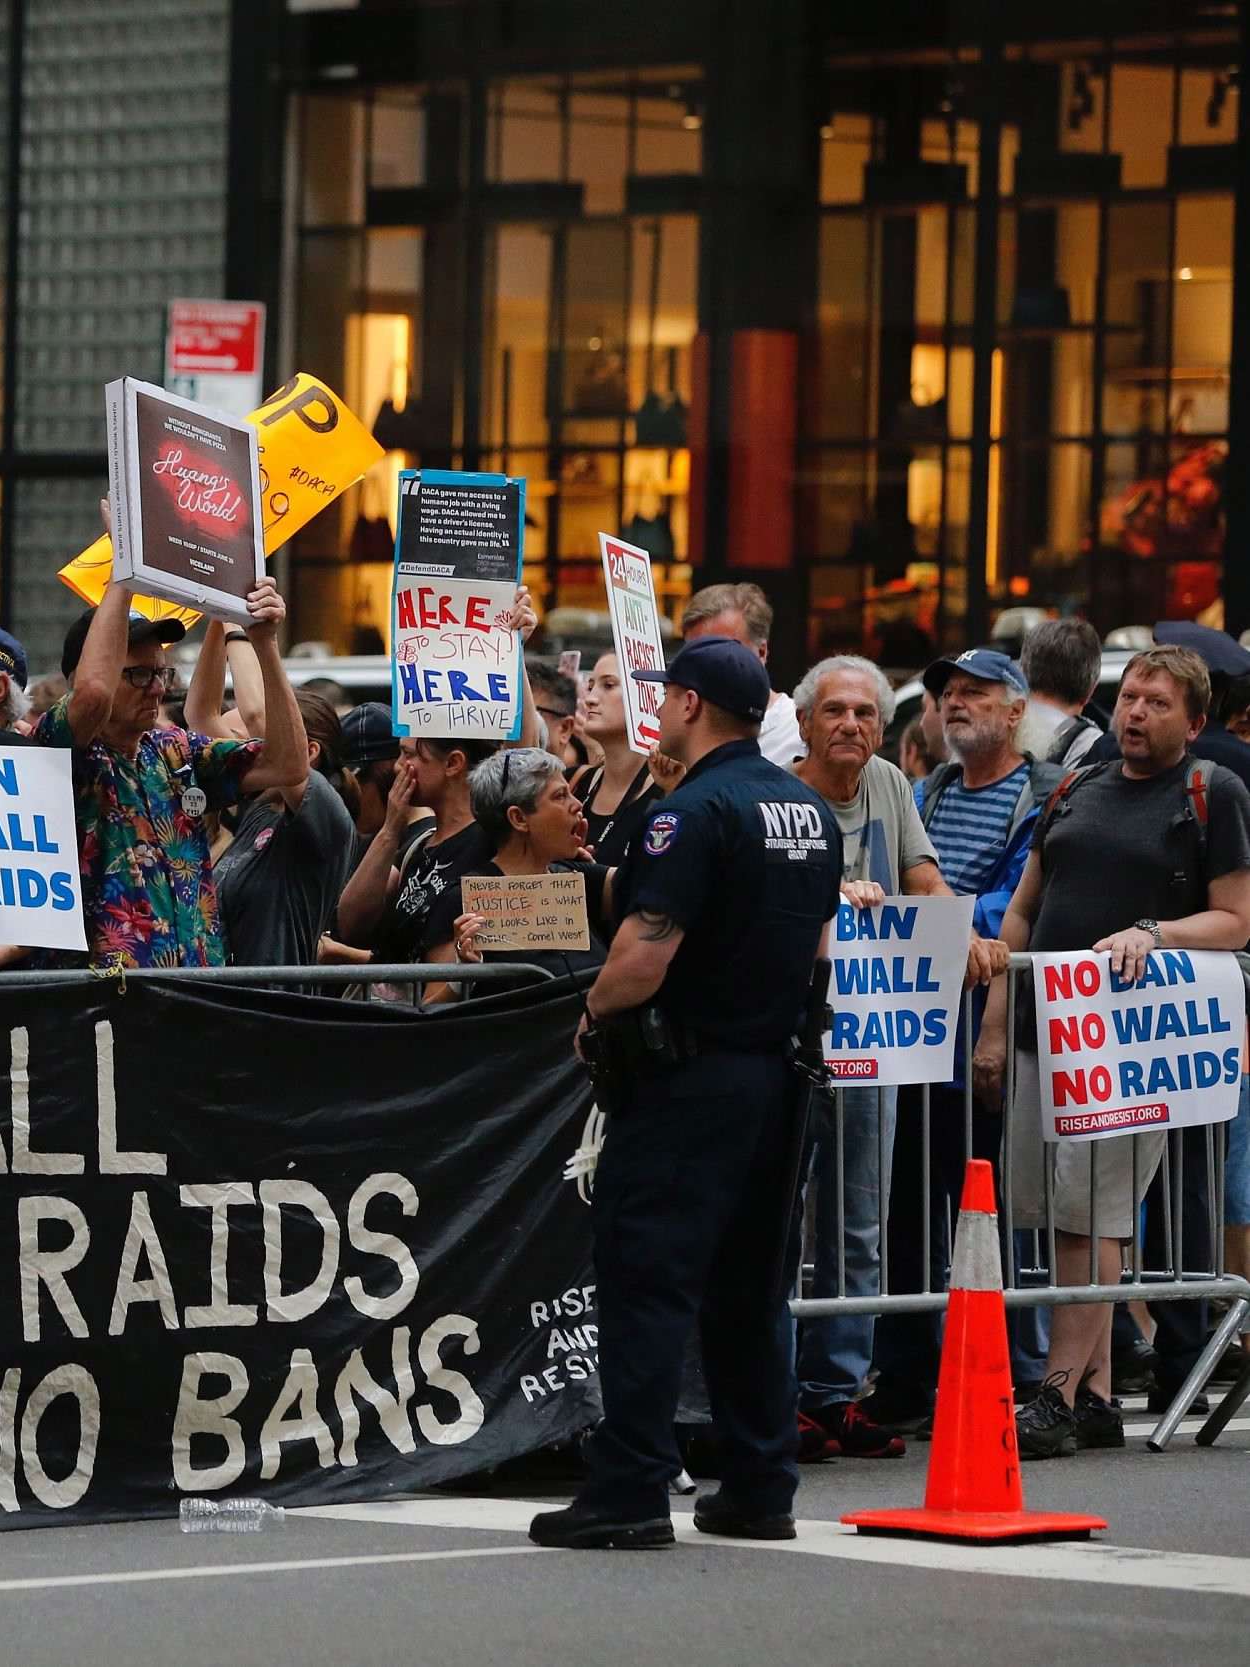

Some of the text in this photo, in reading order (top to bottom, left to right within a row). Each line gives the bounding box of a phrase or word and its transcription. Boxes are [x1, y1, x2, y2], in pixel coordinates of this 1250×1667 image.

[153, 450, 230, 492] Huang's
[177, 476, 241, 522] World
[421, 497, 448, 505] humane
[449, 499, 461, 508] job
[482, 501, 500, 511] living
[421, 508, 441, 516] wage.
[460, 510, 486, 518] allowed
[420, 526, 443, 535] Having
[454, 529, 475, 537] actual
[476, 530, 502, 539] identity
[503, 531, 509, 539] in
[443, 518, 468, 526] driver's
[469, 520, 495, 528] license.
[434, 538, 459, 546] country
[400, 564, 450, 573] #DefendDACA
[610, 553, 626, 582] 24
[626, 564, 647, 587] HOURS
[397, 587, 492, 634] HERE
[625, 636, 656, 672] RACIST
[400, 663, 511, 705] HERE
[410, 702, 512, 730] TO THRIVE
[758, 802, 822, 839] NYPD
[765, 838, 828, 850] STRATEGIC RESPONSE
[788, 849, 808, 860] GROUP
[508, 881, 544, 890] FORGET
[550, 880, 580, 889] THAT
[471, 896, 584, 912] JUSTICE IS WHAT
[500, 918, 530, 928] LOOKS
[837, 903, 919, 942] BAN
[834, 957, 940, 995] WALL
[1043, 960, 1101, 1002] NO
[831, 1009, 947, 1050] RAIDS
[1049, 997, 1231, 1055] NO WALL
[1052, 1047, 1240, 1107] NO RAIDS
[1061, 1106, 1161, 1131] RISEANDRESIST.ORG
[17, 1173, 420, 1342] RAIDS
[530, 1285, 597, 1328] RISE
[547, 1324, 599, 1359] AND
[171, 1314, 486, 1492] BANS
